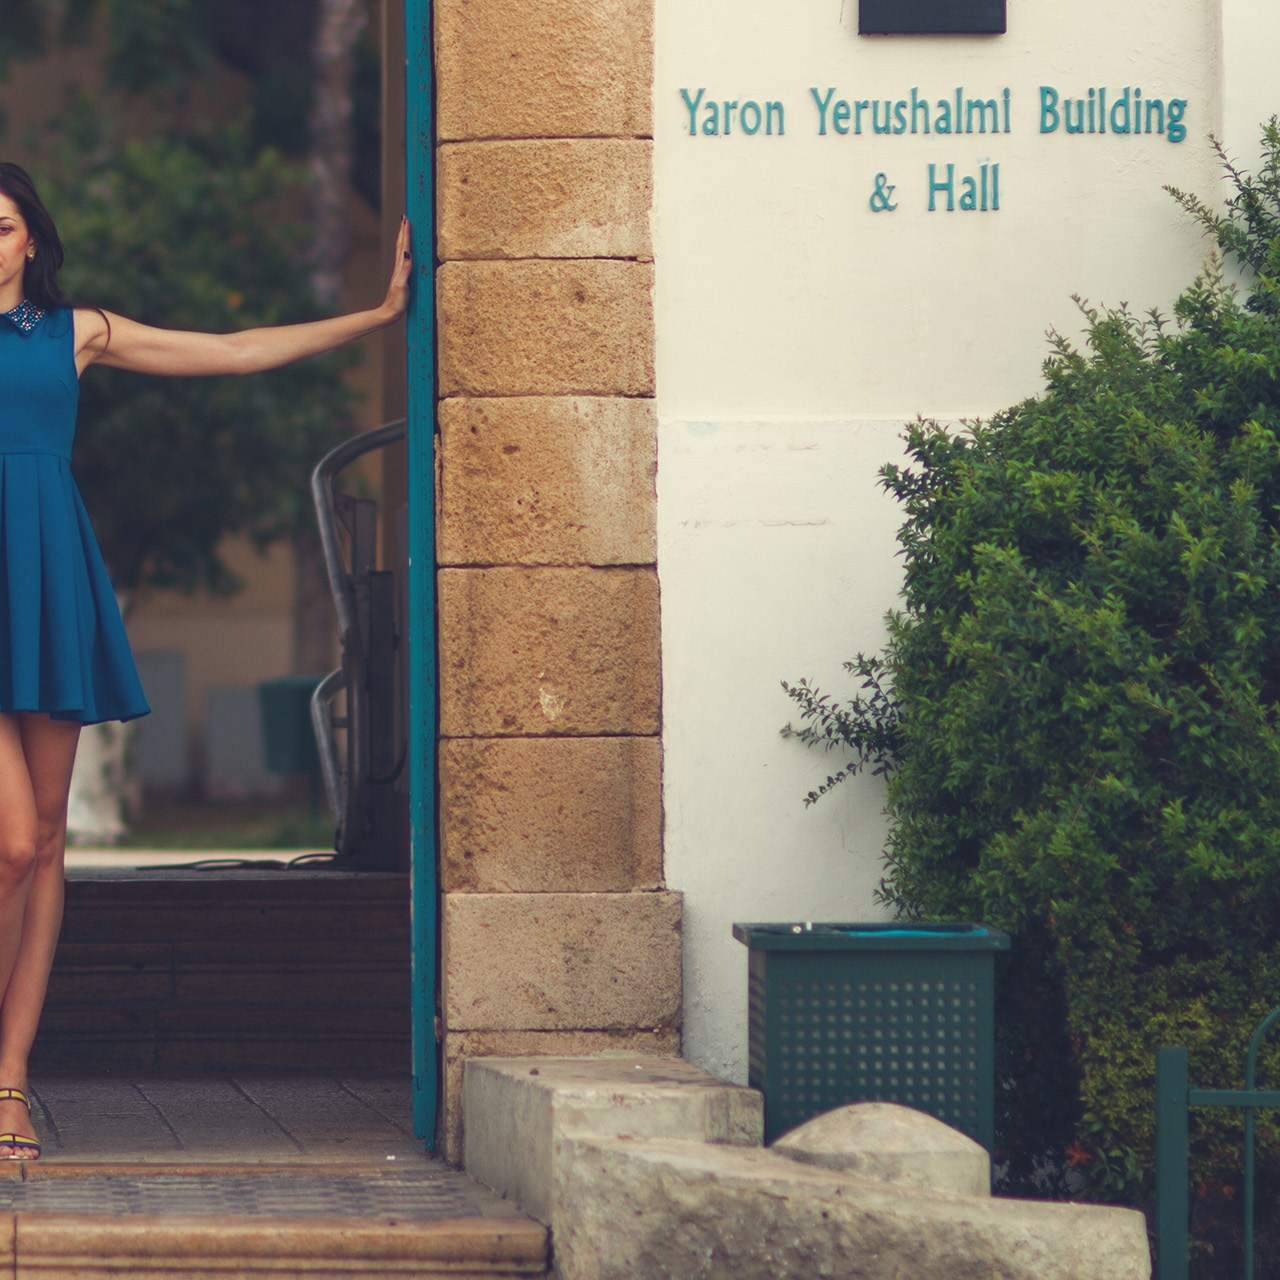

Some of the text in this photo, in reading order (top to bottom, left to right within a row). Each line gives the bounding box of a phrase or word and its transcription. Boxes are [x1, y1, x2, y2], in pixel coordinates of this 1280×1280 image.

[680, 85, 1188, 142] Yaron Yerushalmi Building
[869, 163, 1000, 213] & Hall
